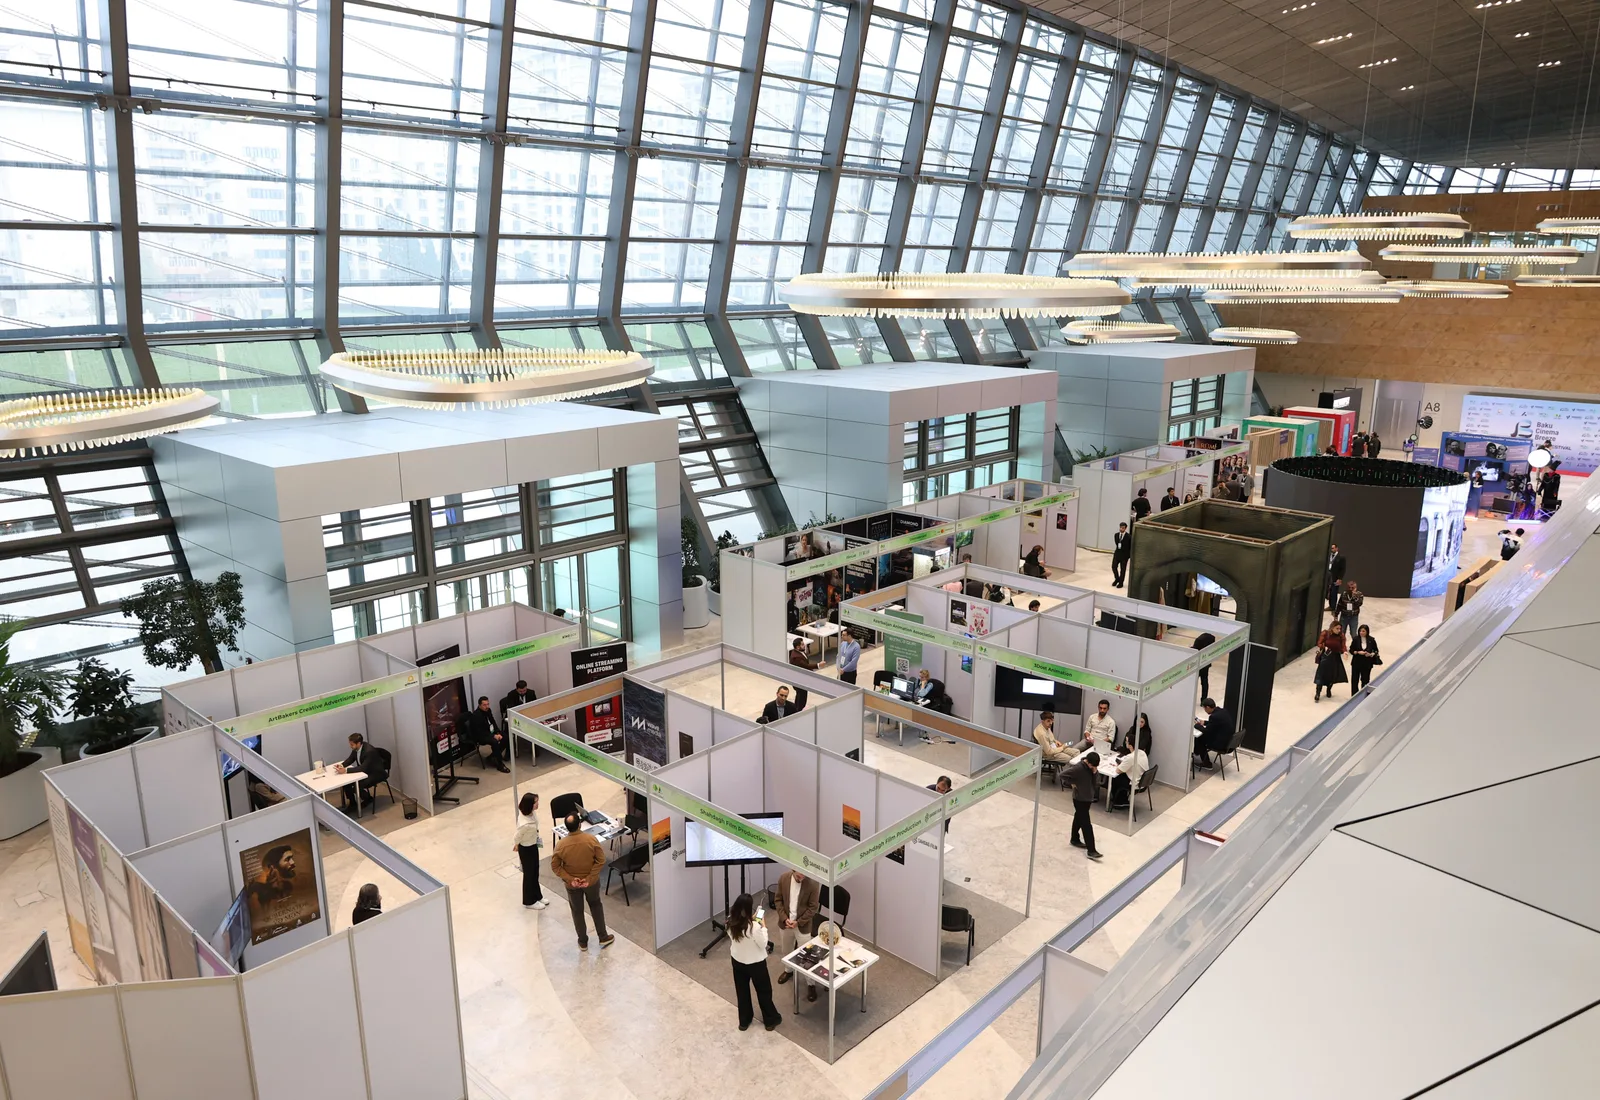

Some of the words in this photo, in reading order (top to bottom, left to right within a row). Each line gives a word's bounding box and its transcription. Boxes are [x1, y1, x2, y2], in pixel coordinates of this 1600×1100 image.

[1424, 403, 1441, 411] A8
[1536, 421, 1553, 429] Baku
[1535, 428, 1560, 436] Cinema
[1534, 434, 1557, 442] Breeze
[873, 618, 892, 627] Azerbaijan
[893, 624, 912, 632] Animation
[913, 629, 935, 639] Association
[953, 640, 971, 649] anima
[473, 657, 491, 665] Kinobox
[492, 651, 515, 660] Streaming
[516, 644, 535, 653] Platform
[576, 662, 594, 670] ONLINE
[595, 658, 623, 667] STREAMING
[587, 665, 613, 674] PLATFORM
[1048, 667, 1072, 677] Animation
[1122, 686, 1138, 697] 3Dost
[268, 711, 298, 723] ArtBakers
[299, 703, 322, 714] Creative
[324, 693, 355, 708] Advertising
[357, 688, 377, 698] Agency
[552, 738, 563, 748] Wave
[563, 744, 576, 754] Media
[576, 749, 598, 763] Production
[971, 785, 986, 795] Chinar
[985, 780, 996, 789] Film
[996, 769, 1018, 782] Production
[701, 809, 725, 824] Shahdagh
[725, 820, 738, 830] Film
[739, 826, 767, 844] Production
[860, 842, 884, 859] Shahdagh
[885, 835, 897, 844] Film
[897, 820, 921, 836] Production
